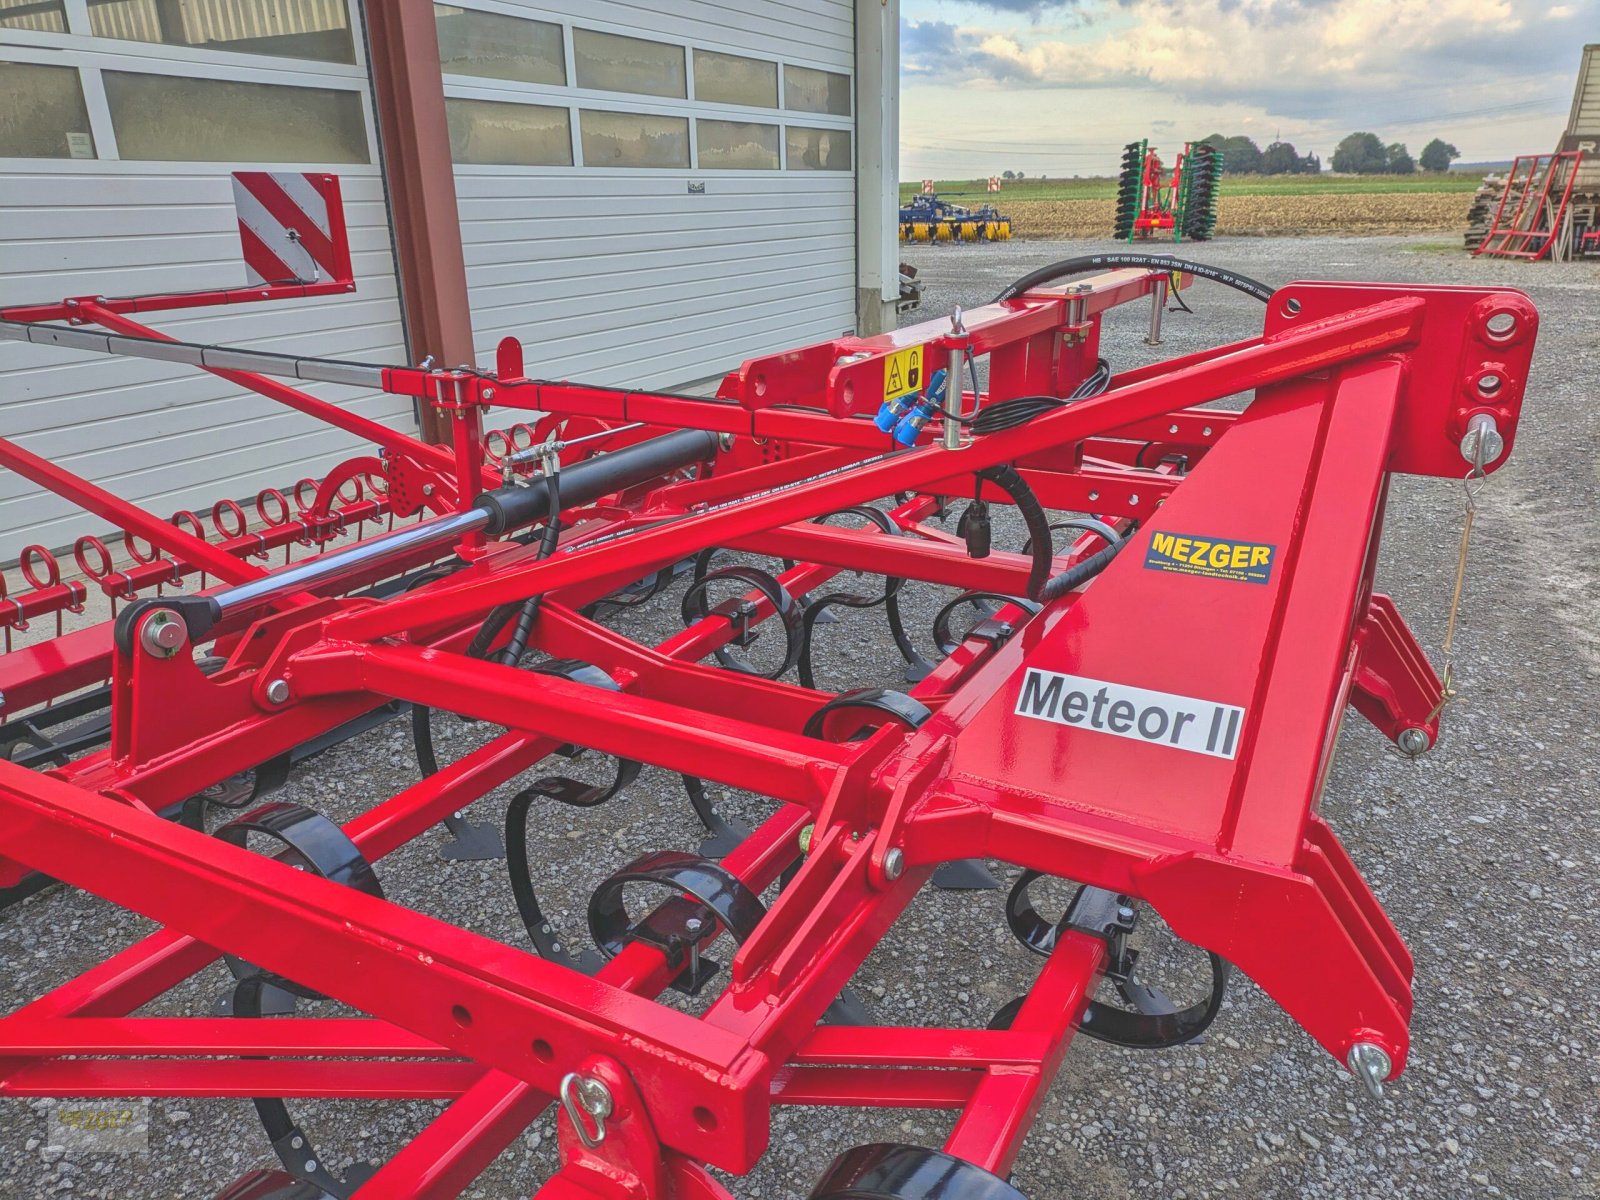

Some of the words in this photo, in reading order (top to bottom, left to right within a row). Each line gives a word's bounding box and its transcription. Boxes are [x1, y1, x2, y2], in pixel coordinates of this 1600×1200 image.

[1170, 260, 1182, 268] 2SN
[1151, 532, 1271, 569] MEZGER
[1018, 671, 1196, 745] Meteor
[1205, 706, 1241, 756] II
